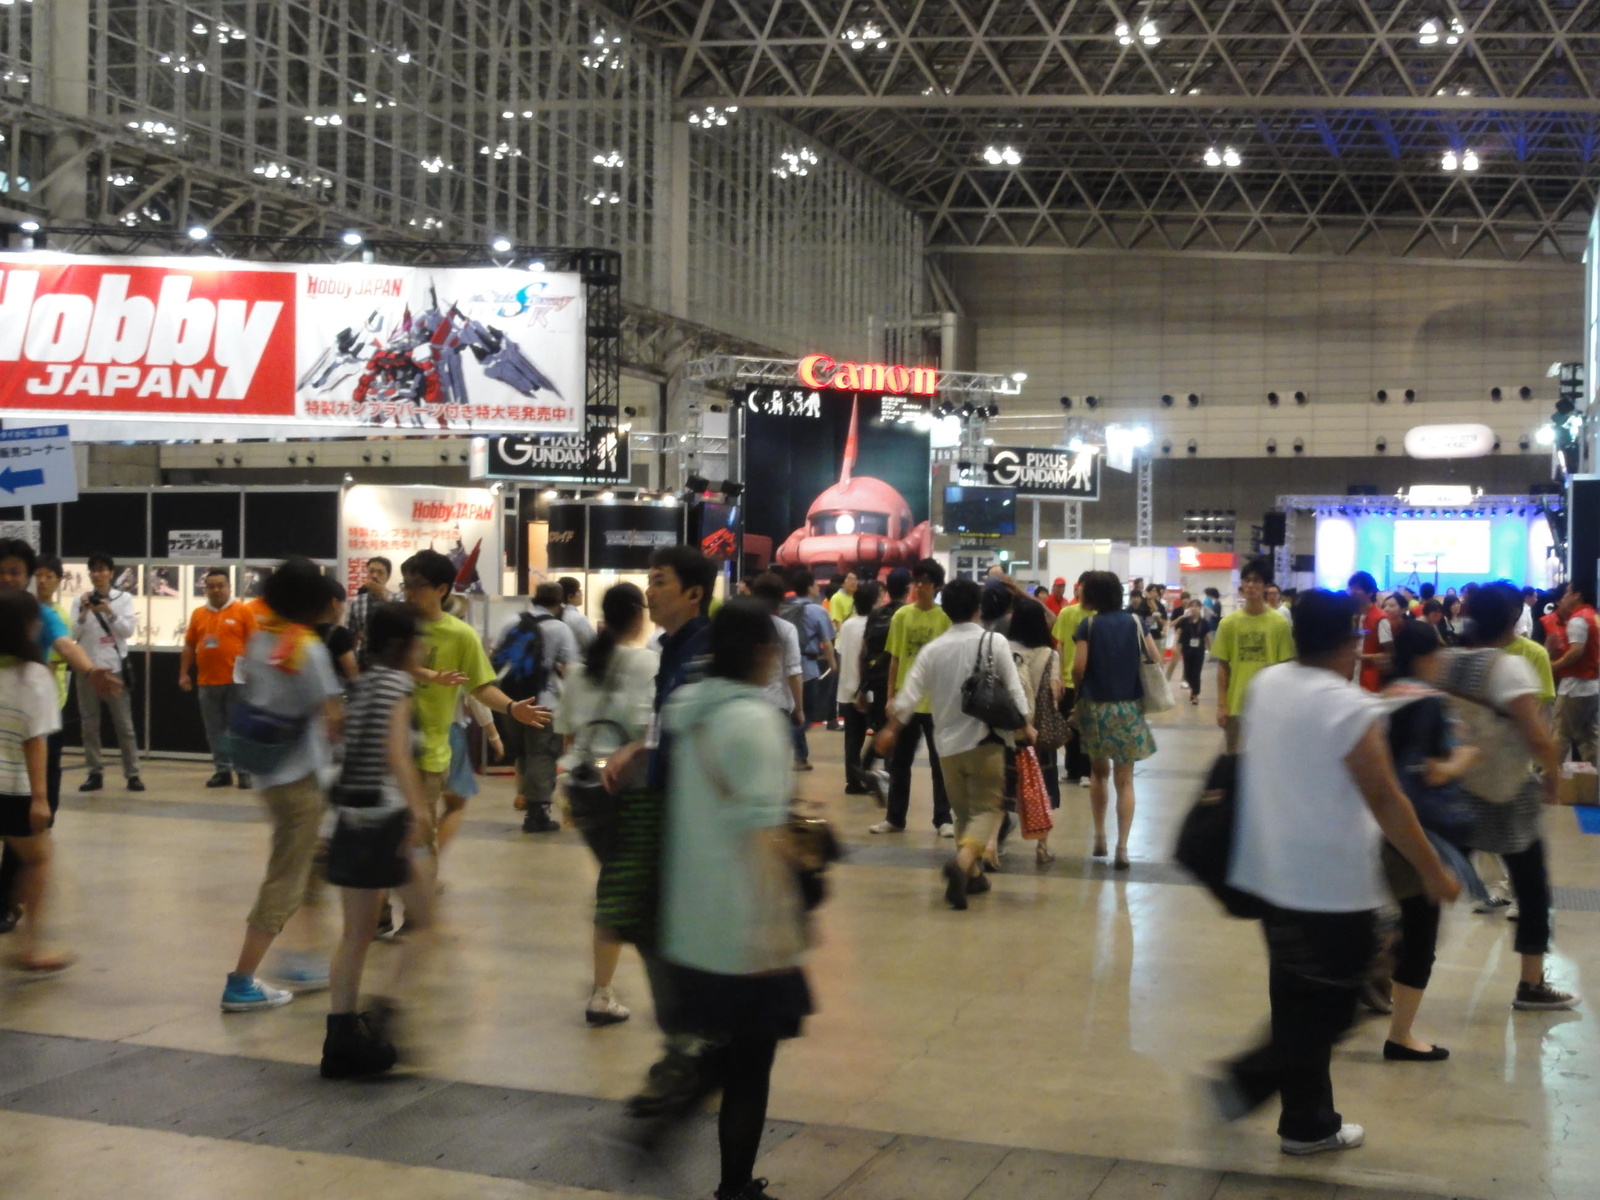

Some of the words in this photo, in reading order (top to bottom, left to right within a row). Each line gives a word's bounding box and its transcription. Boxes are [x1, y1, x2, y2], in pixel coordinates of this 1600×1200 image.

[306, 275, 352, 299] Hobby
[355, 278, 403, 297] JAPAN
[26, 364, 216, 399] JAPAN
[798, 353, 936, 396] Canon
[993, 450, 1069, 485] GUNDAM
[1026, 453, 1068, 468] PIXUS
[412, 501, 453, 522] Hobby
[455, 502, 493, 520] JAPAN
